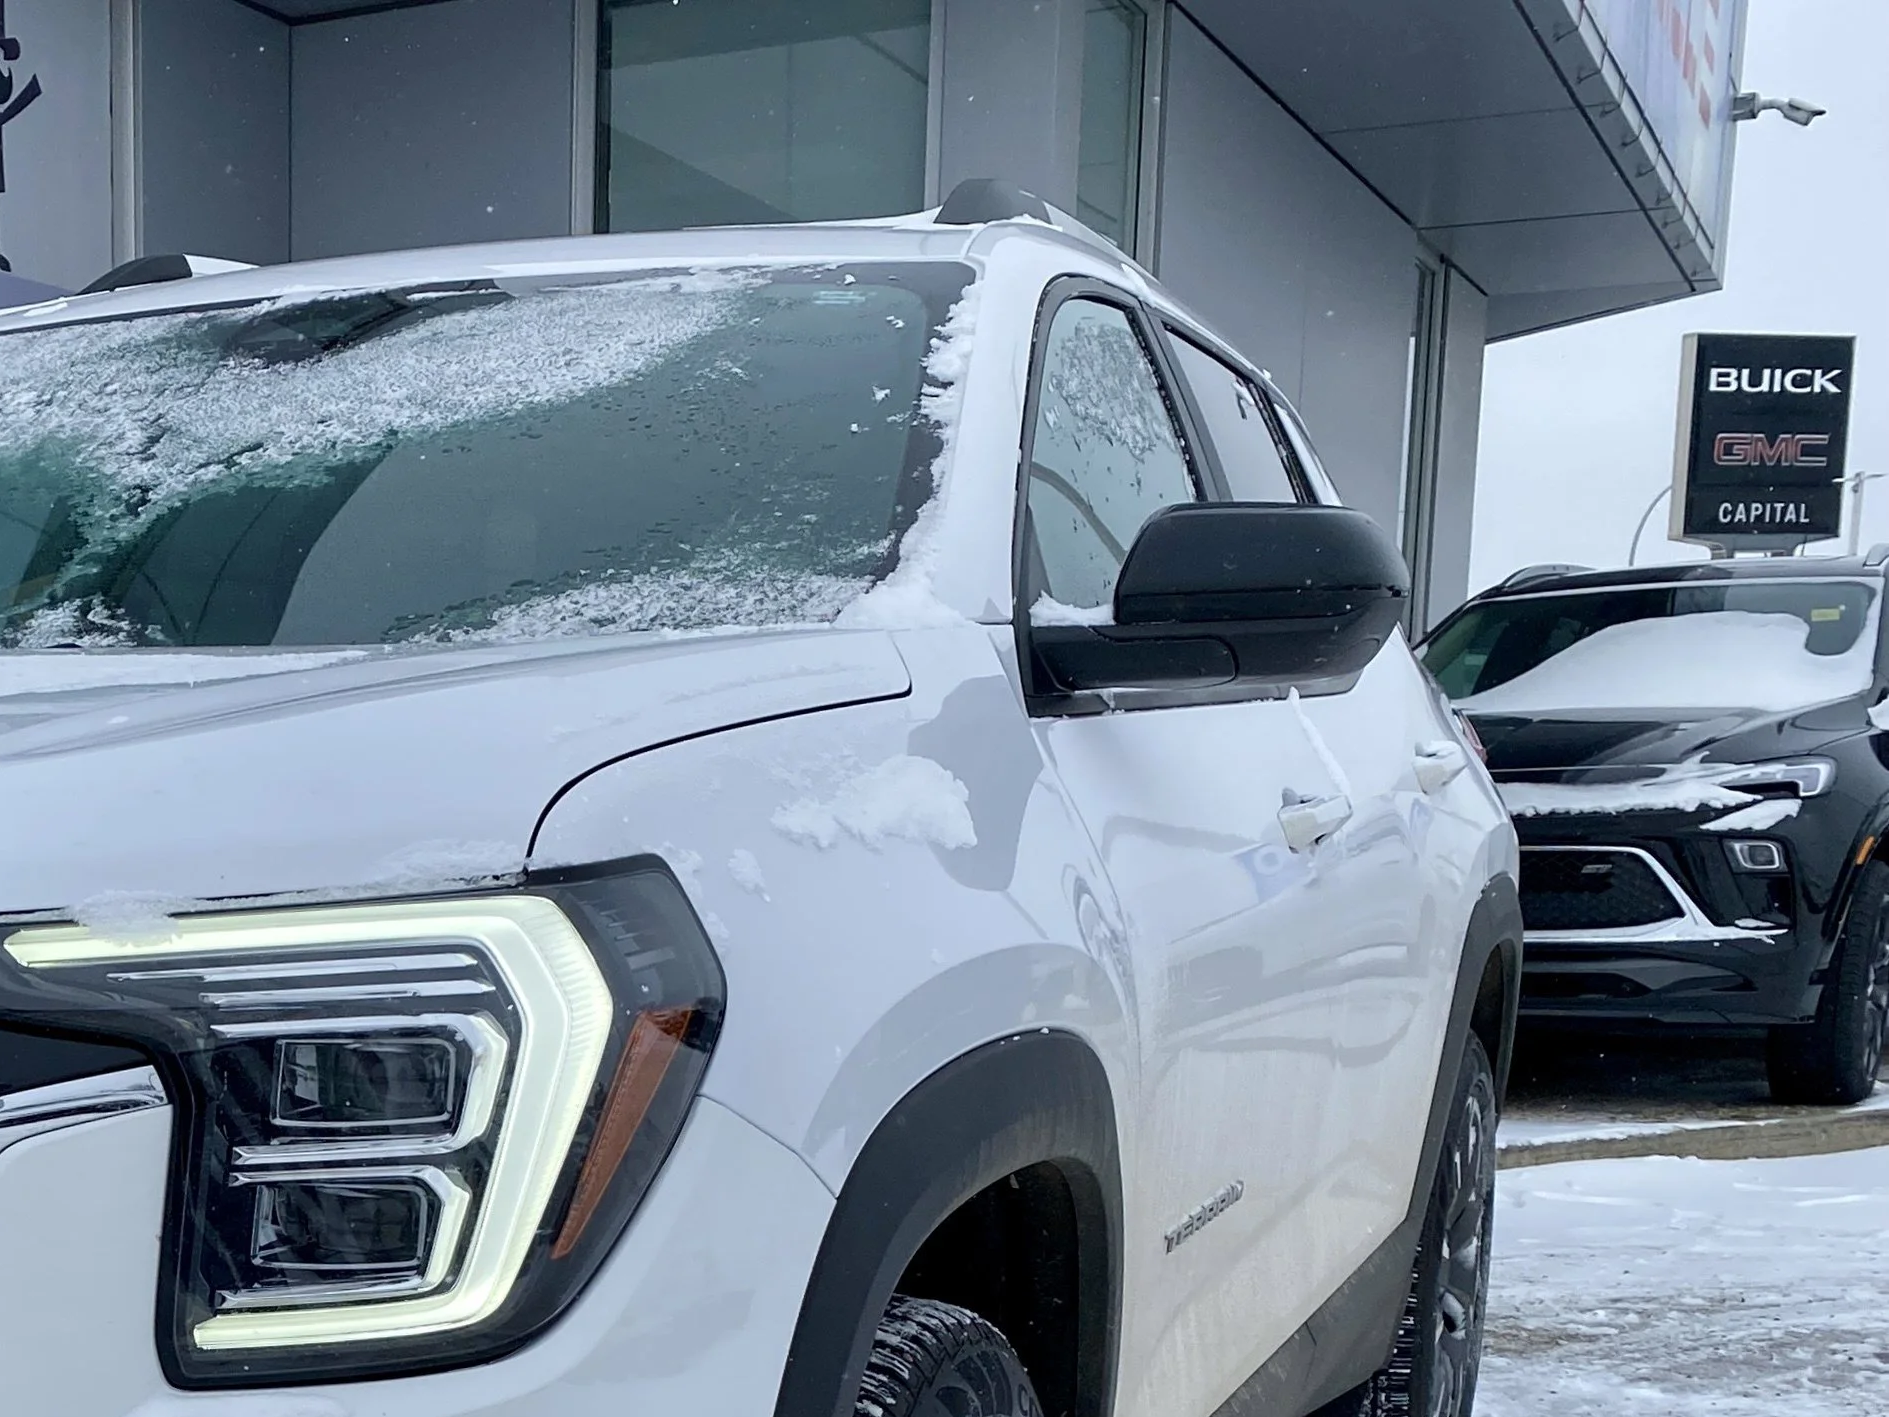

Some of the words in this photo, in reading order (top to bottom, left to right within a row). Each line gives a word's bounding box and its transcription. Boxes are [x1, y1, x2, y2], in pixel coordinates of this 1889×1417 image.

[1709, 367, 1842, 393] BUICK
[1713, 433, 1831, 466] GMC
[1718, 503, 1810, 523] CAPITAL
